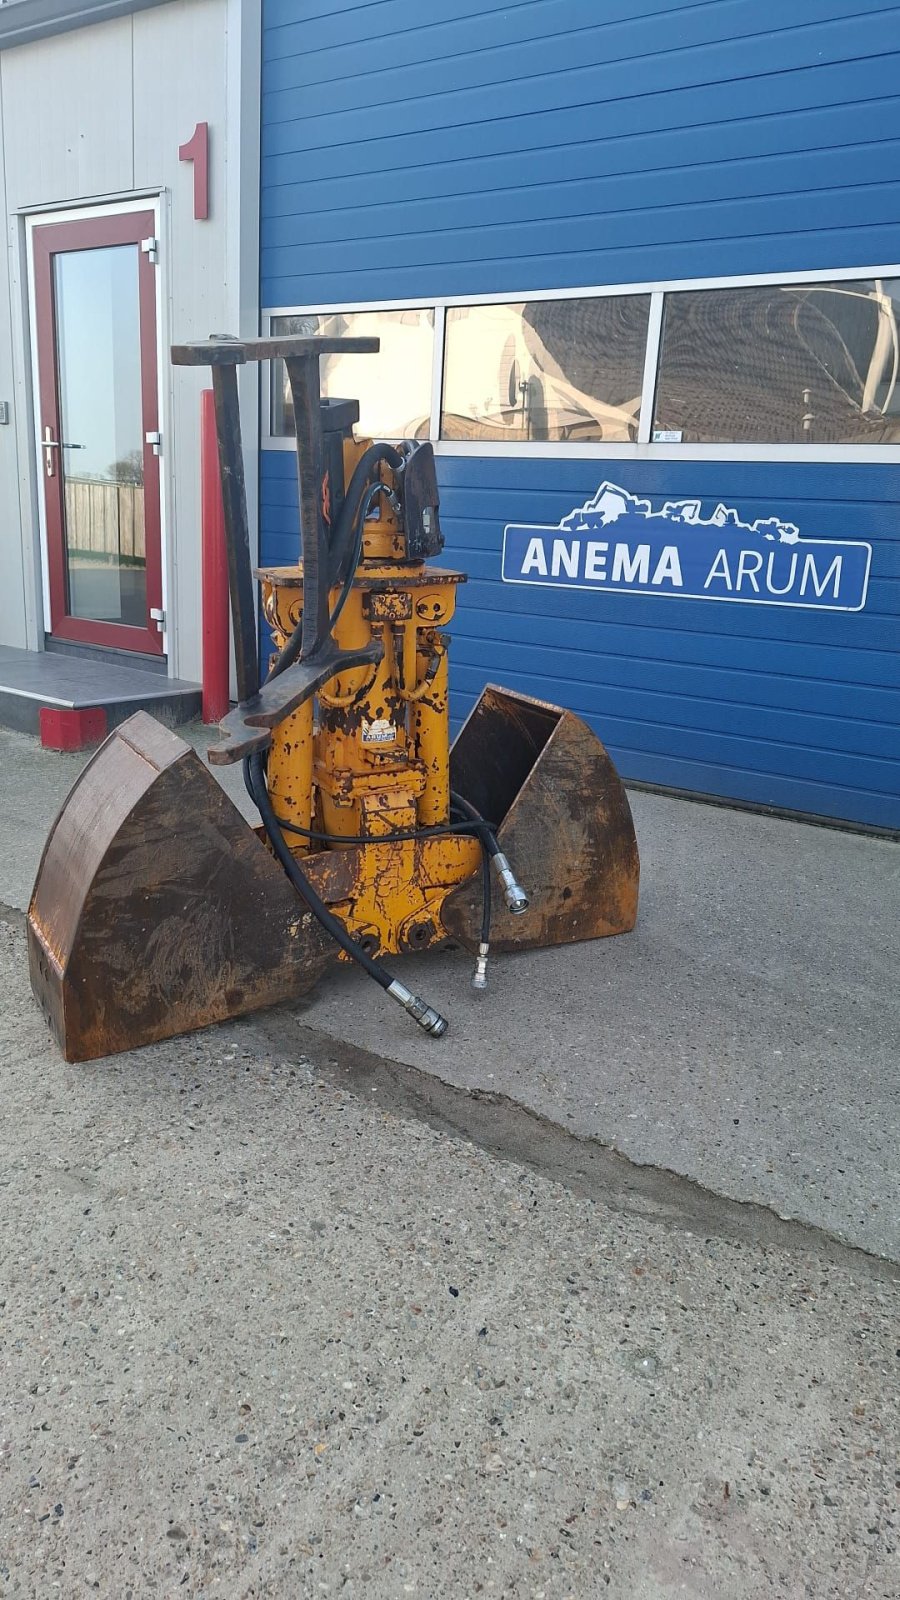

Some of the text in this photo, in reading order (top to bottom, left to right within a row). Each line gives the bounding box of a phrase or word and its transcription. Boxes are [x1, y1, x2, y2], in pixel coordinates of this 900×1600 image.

[178, 122, 208, 219] 1
[520, 537, 843, 599] ANEMA ARUM
